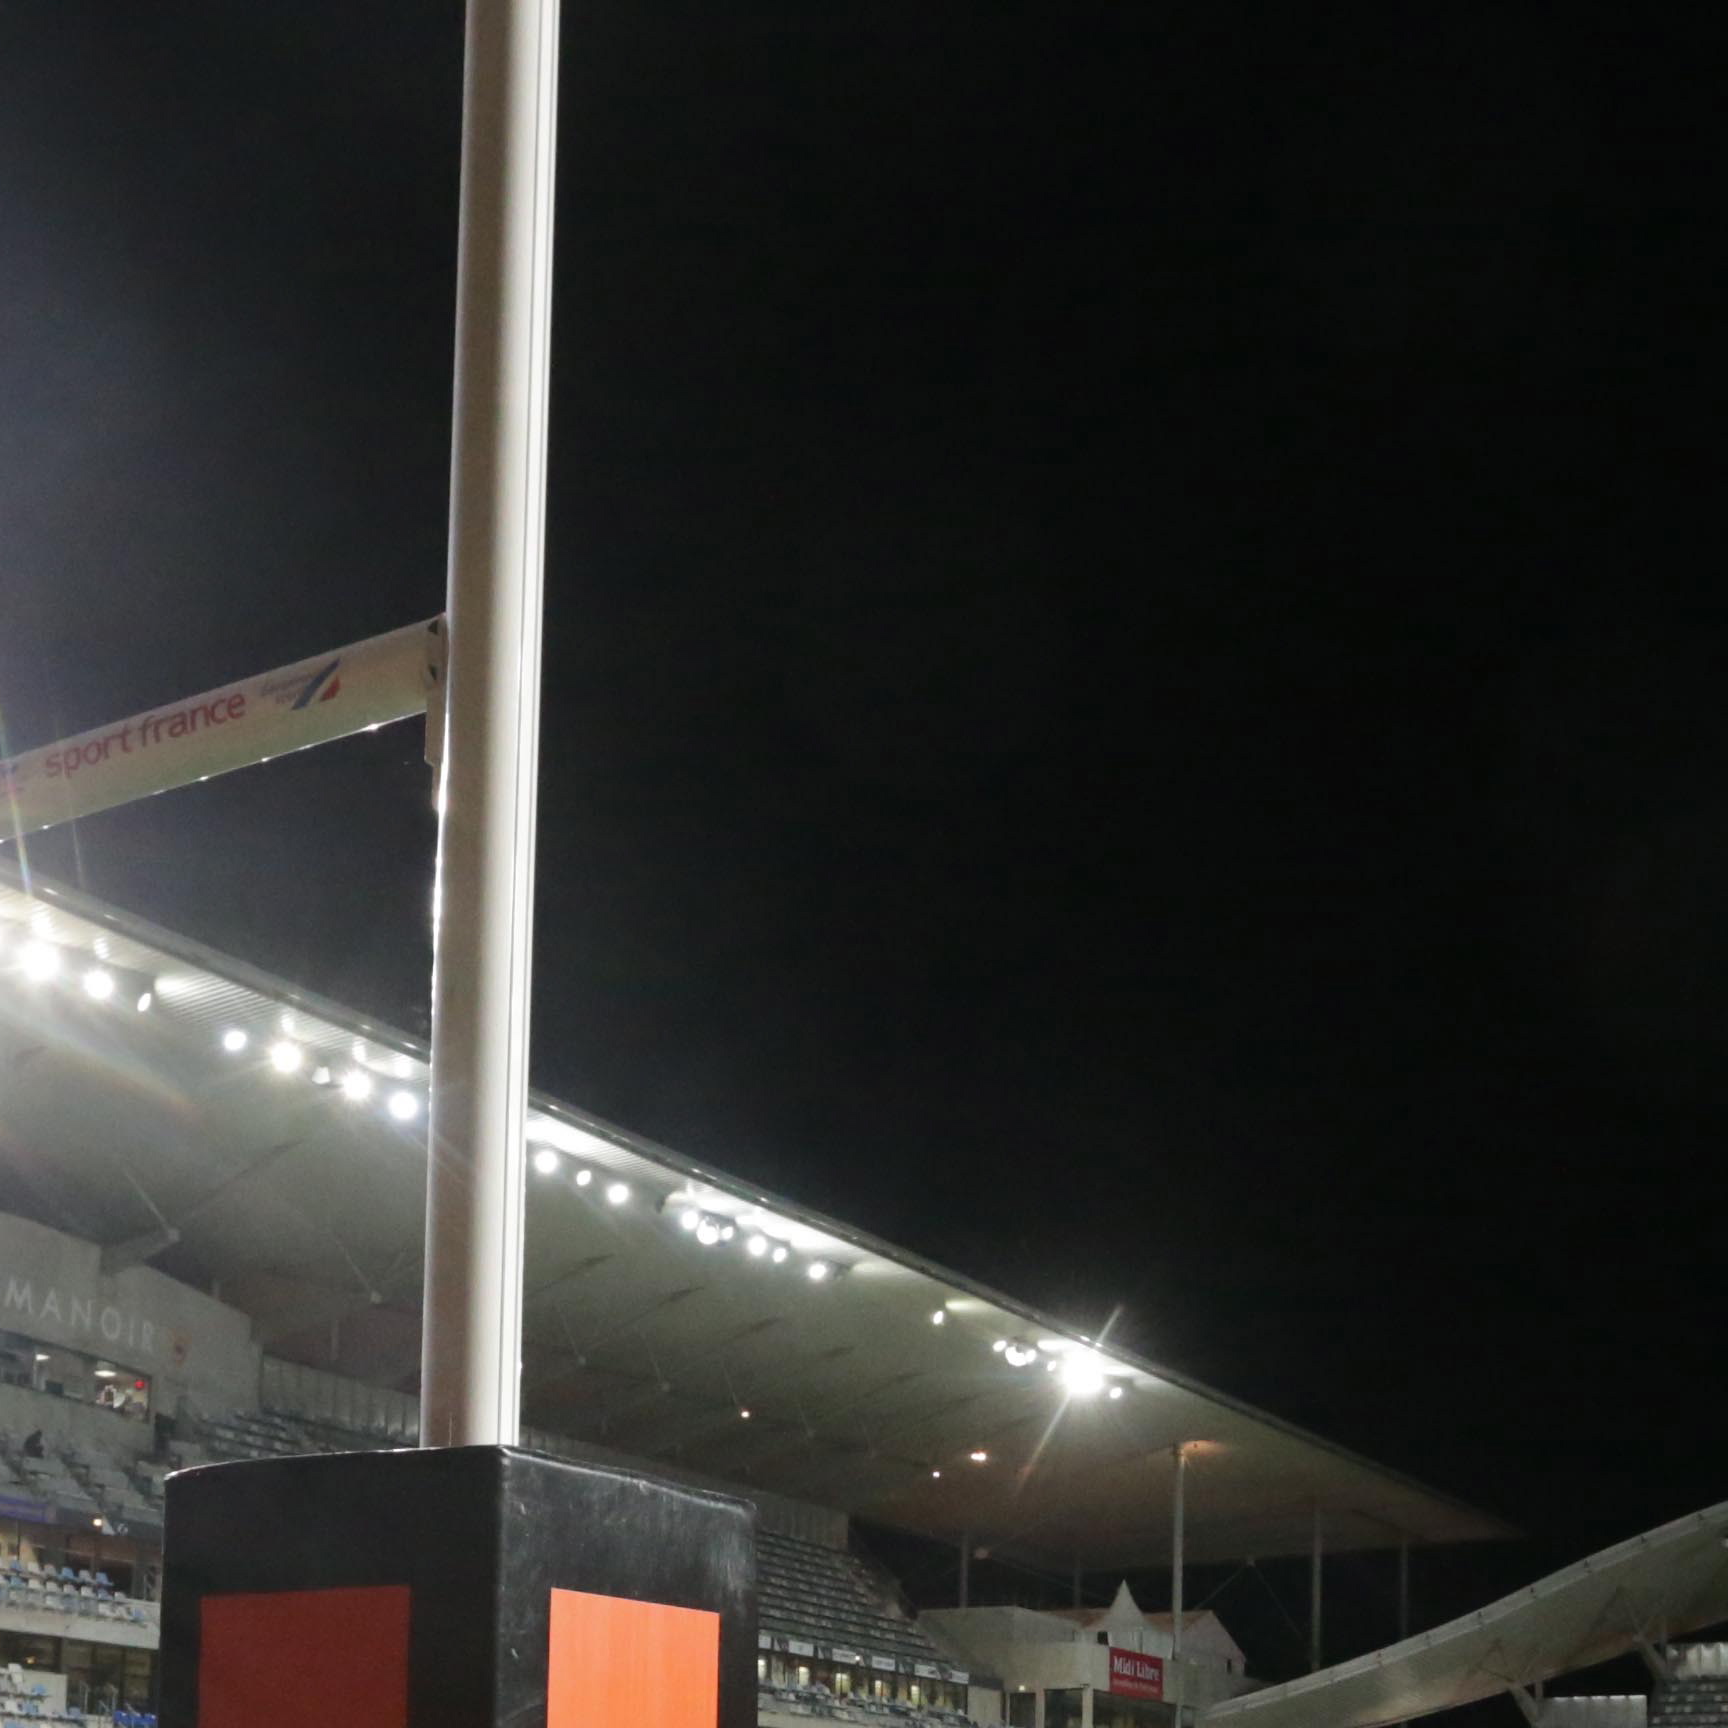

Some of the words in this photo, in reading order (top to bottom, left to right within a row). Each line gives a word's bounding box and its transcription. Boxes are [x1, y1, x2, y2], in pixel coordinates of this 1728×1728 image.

[46, 726, 134, 779] sport
[138, 693, 246, 748] france
[3, 1279, 156, 1357] MANOIR
